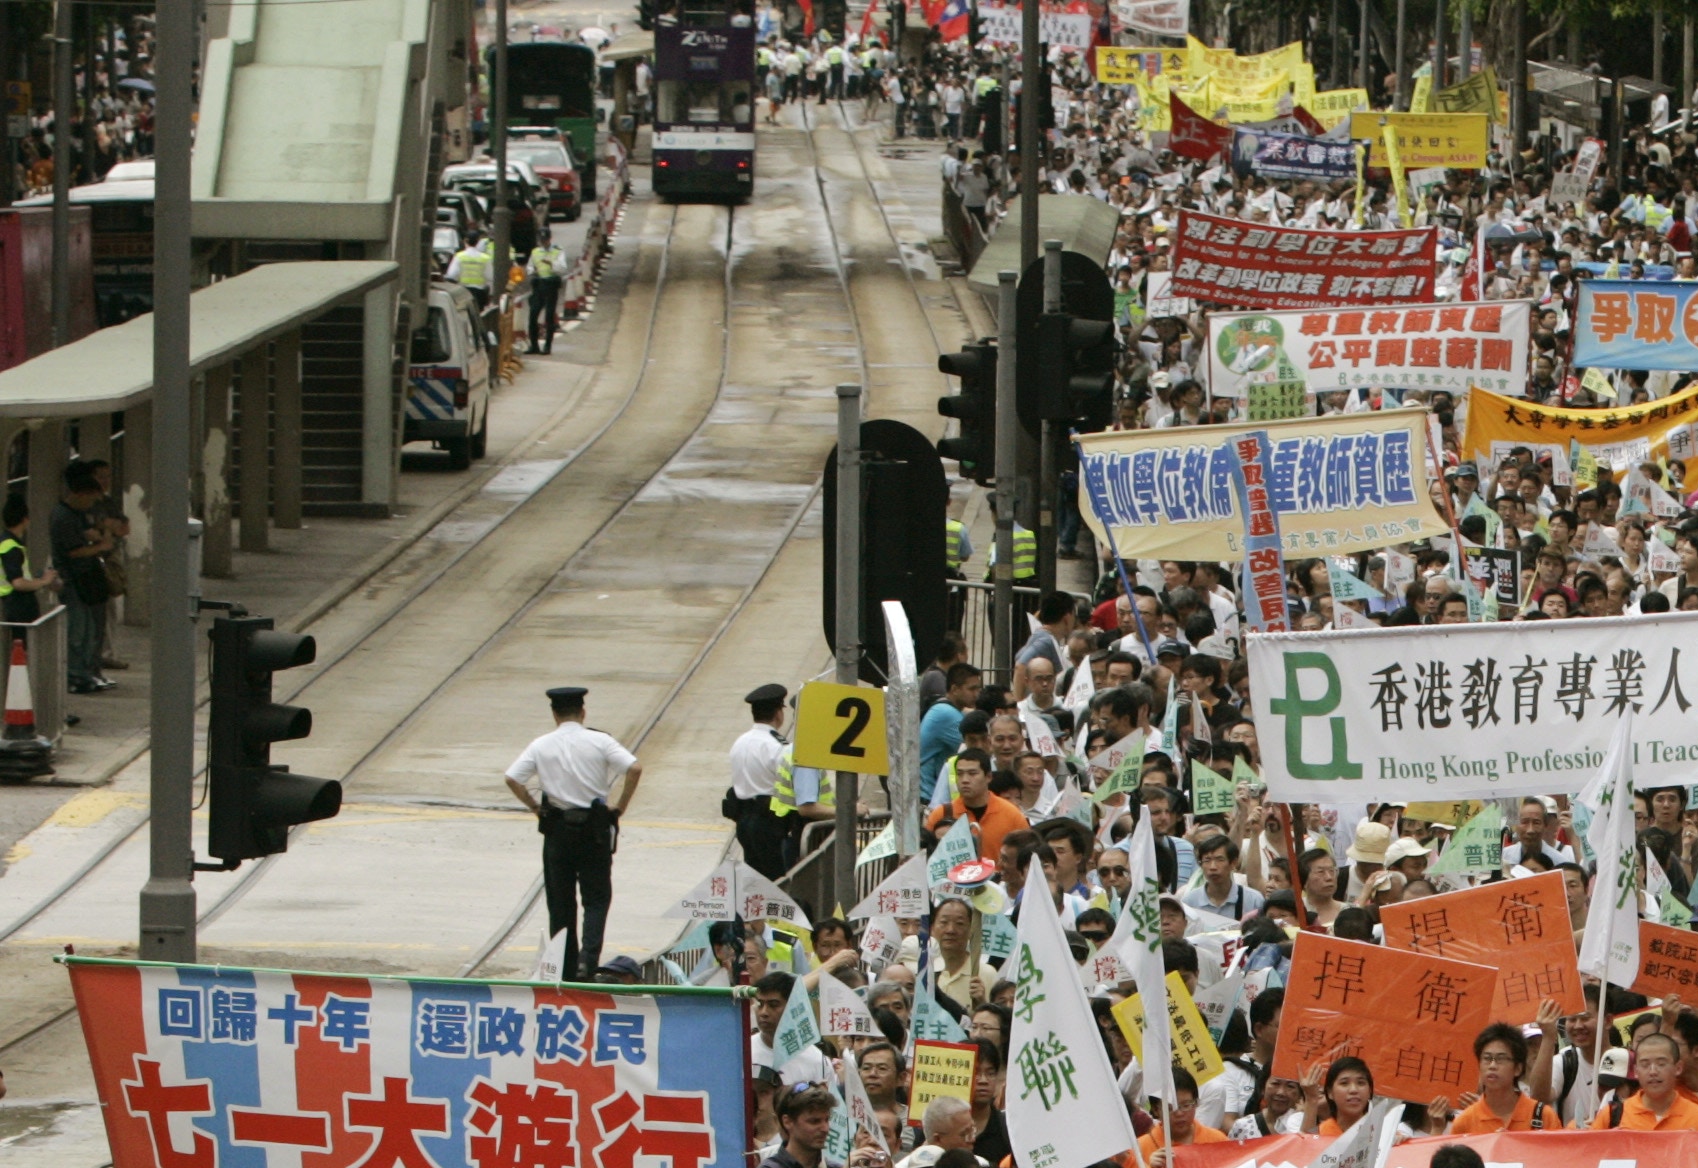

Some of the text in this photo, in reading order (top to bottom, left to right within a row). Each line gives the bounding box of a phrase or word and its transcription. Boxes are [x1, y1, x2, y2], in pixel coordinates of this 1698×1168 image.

[1181, 239, 1199, 250] The
[1236, 249, 1252, 260] for
[1254, 252, 1271, 262] the
[1274, 254, 1314, 267] Concern
[1331, 257, 1384, 270] Sub-degree
[1183, 217, 1431, 257] 關注副學位大聯盟
[1174, 256, 1326, 296] 改革副學位政策
[1299, 305, 1504, 337] 尊重教師資歷
[1590, 292, 1676, 344] 爭取
[1307, 337, 1513, 372] 公平調整薪酬
[1350, 371, 1510, 390] 香港教育專業人員協會
[1082, 428, 1417, 527] 增加學位教席 重教師資歷
[830, 697, 872, 758] 2
[1378, 754, 1437, 787] Hong
[1441, 751, 1500, 783] Kong
[1505, 738, 1641, 775] Professiol
[1196, 788, 1234, 810] 民主
[766, 900, 796, 920] 普選
[1314, 949, 1468, 1026] 捍衛
[157, 987, 648, 1067] 回歸十年 還政於民
[1394, 1047, 1465, 1090] 自由
